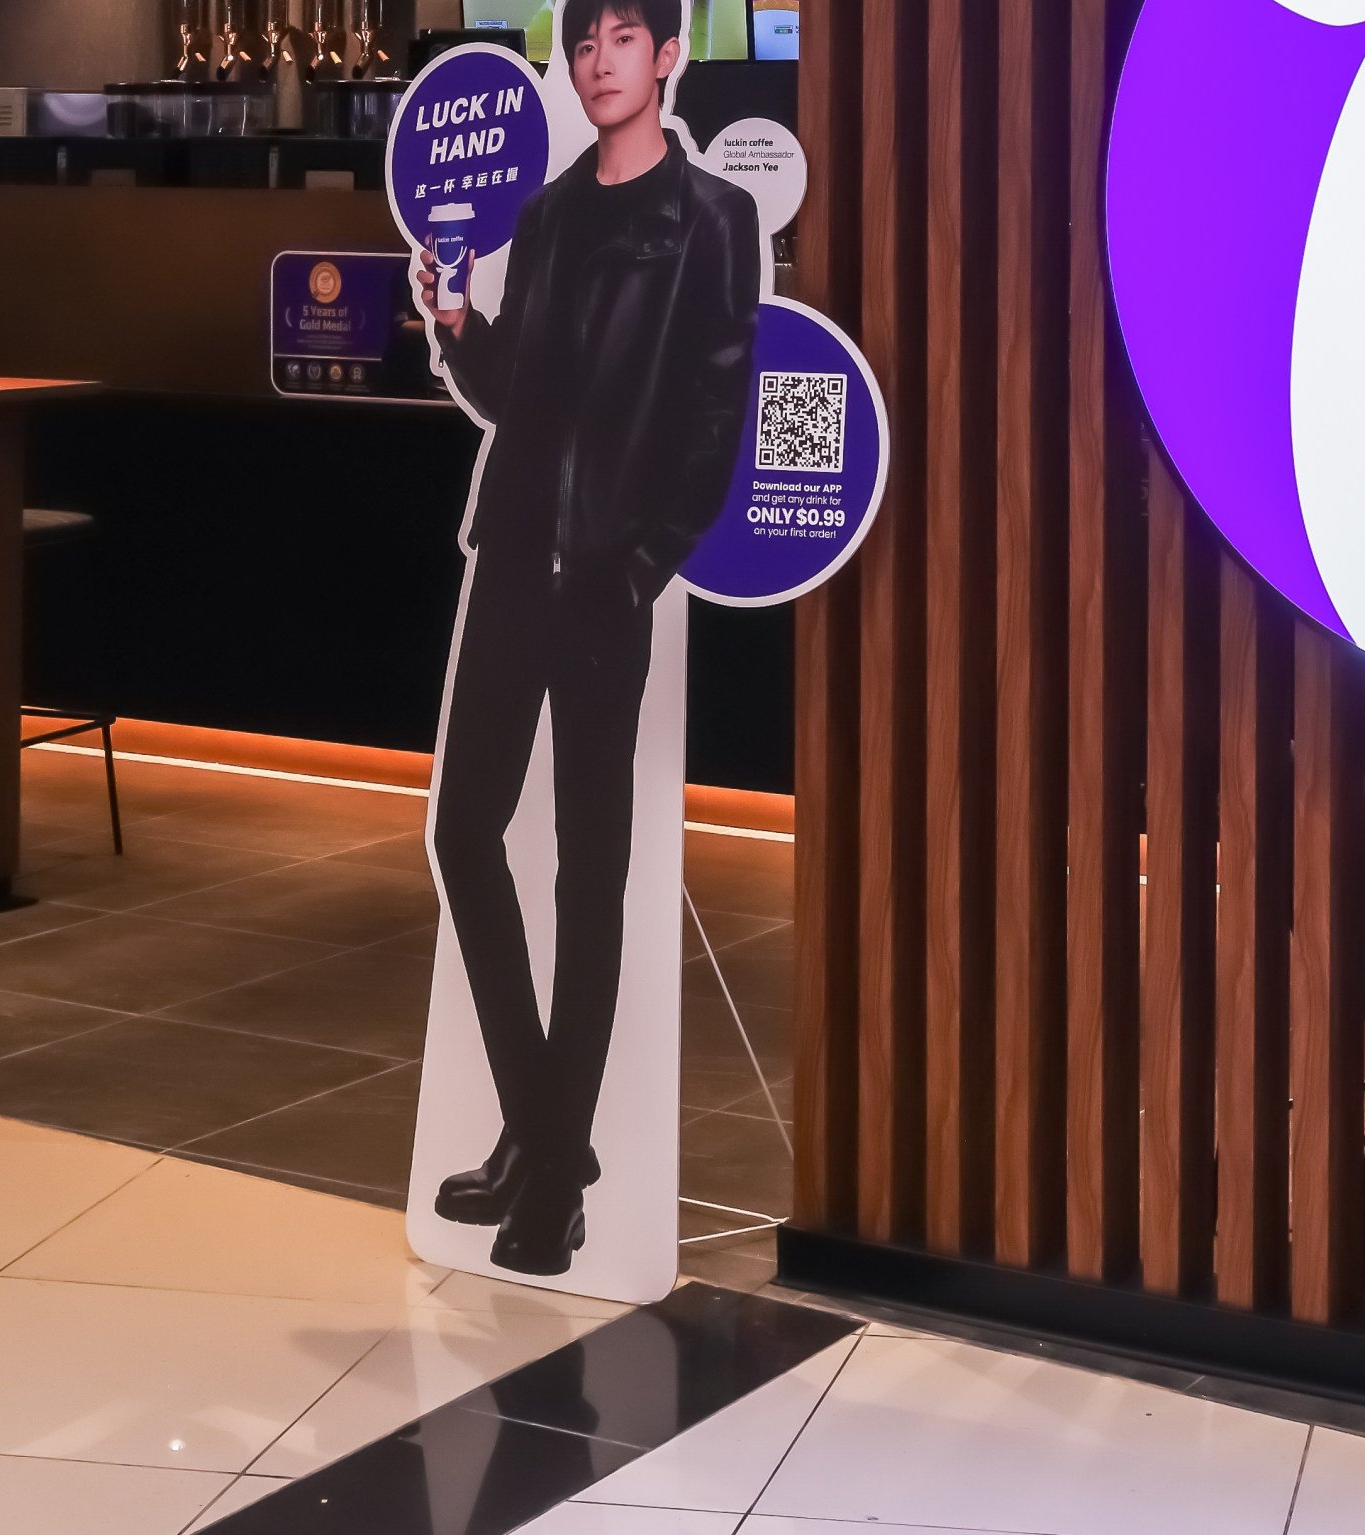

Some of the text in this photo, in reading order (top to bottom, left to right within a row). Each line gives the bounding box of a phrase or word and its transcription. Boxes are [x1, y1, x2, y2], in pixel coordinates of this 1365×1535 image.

[416, 86, 523, 131] LUCK IN
[430, 127, 505, 164] HAND
[724, 139, 773, 147] luckin coffee
[723, 151, 794, 159] Global Ambassador
[723, 163, 779, 172] Jackson Yee
[303, 305, 348, 317] 5 Years of
[299, 318, 351, 332] Gold Medal
[753, 480, 842, 494] Download our APP
[752, 494, 841, 506] and get any drink for
[747, 506, 845, 527] ONLY $0.99
[753, 527, 836, 539] on your first order!
